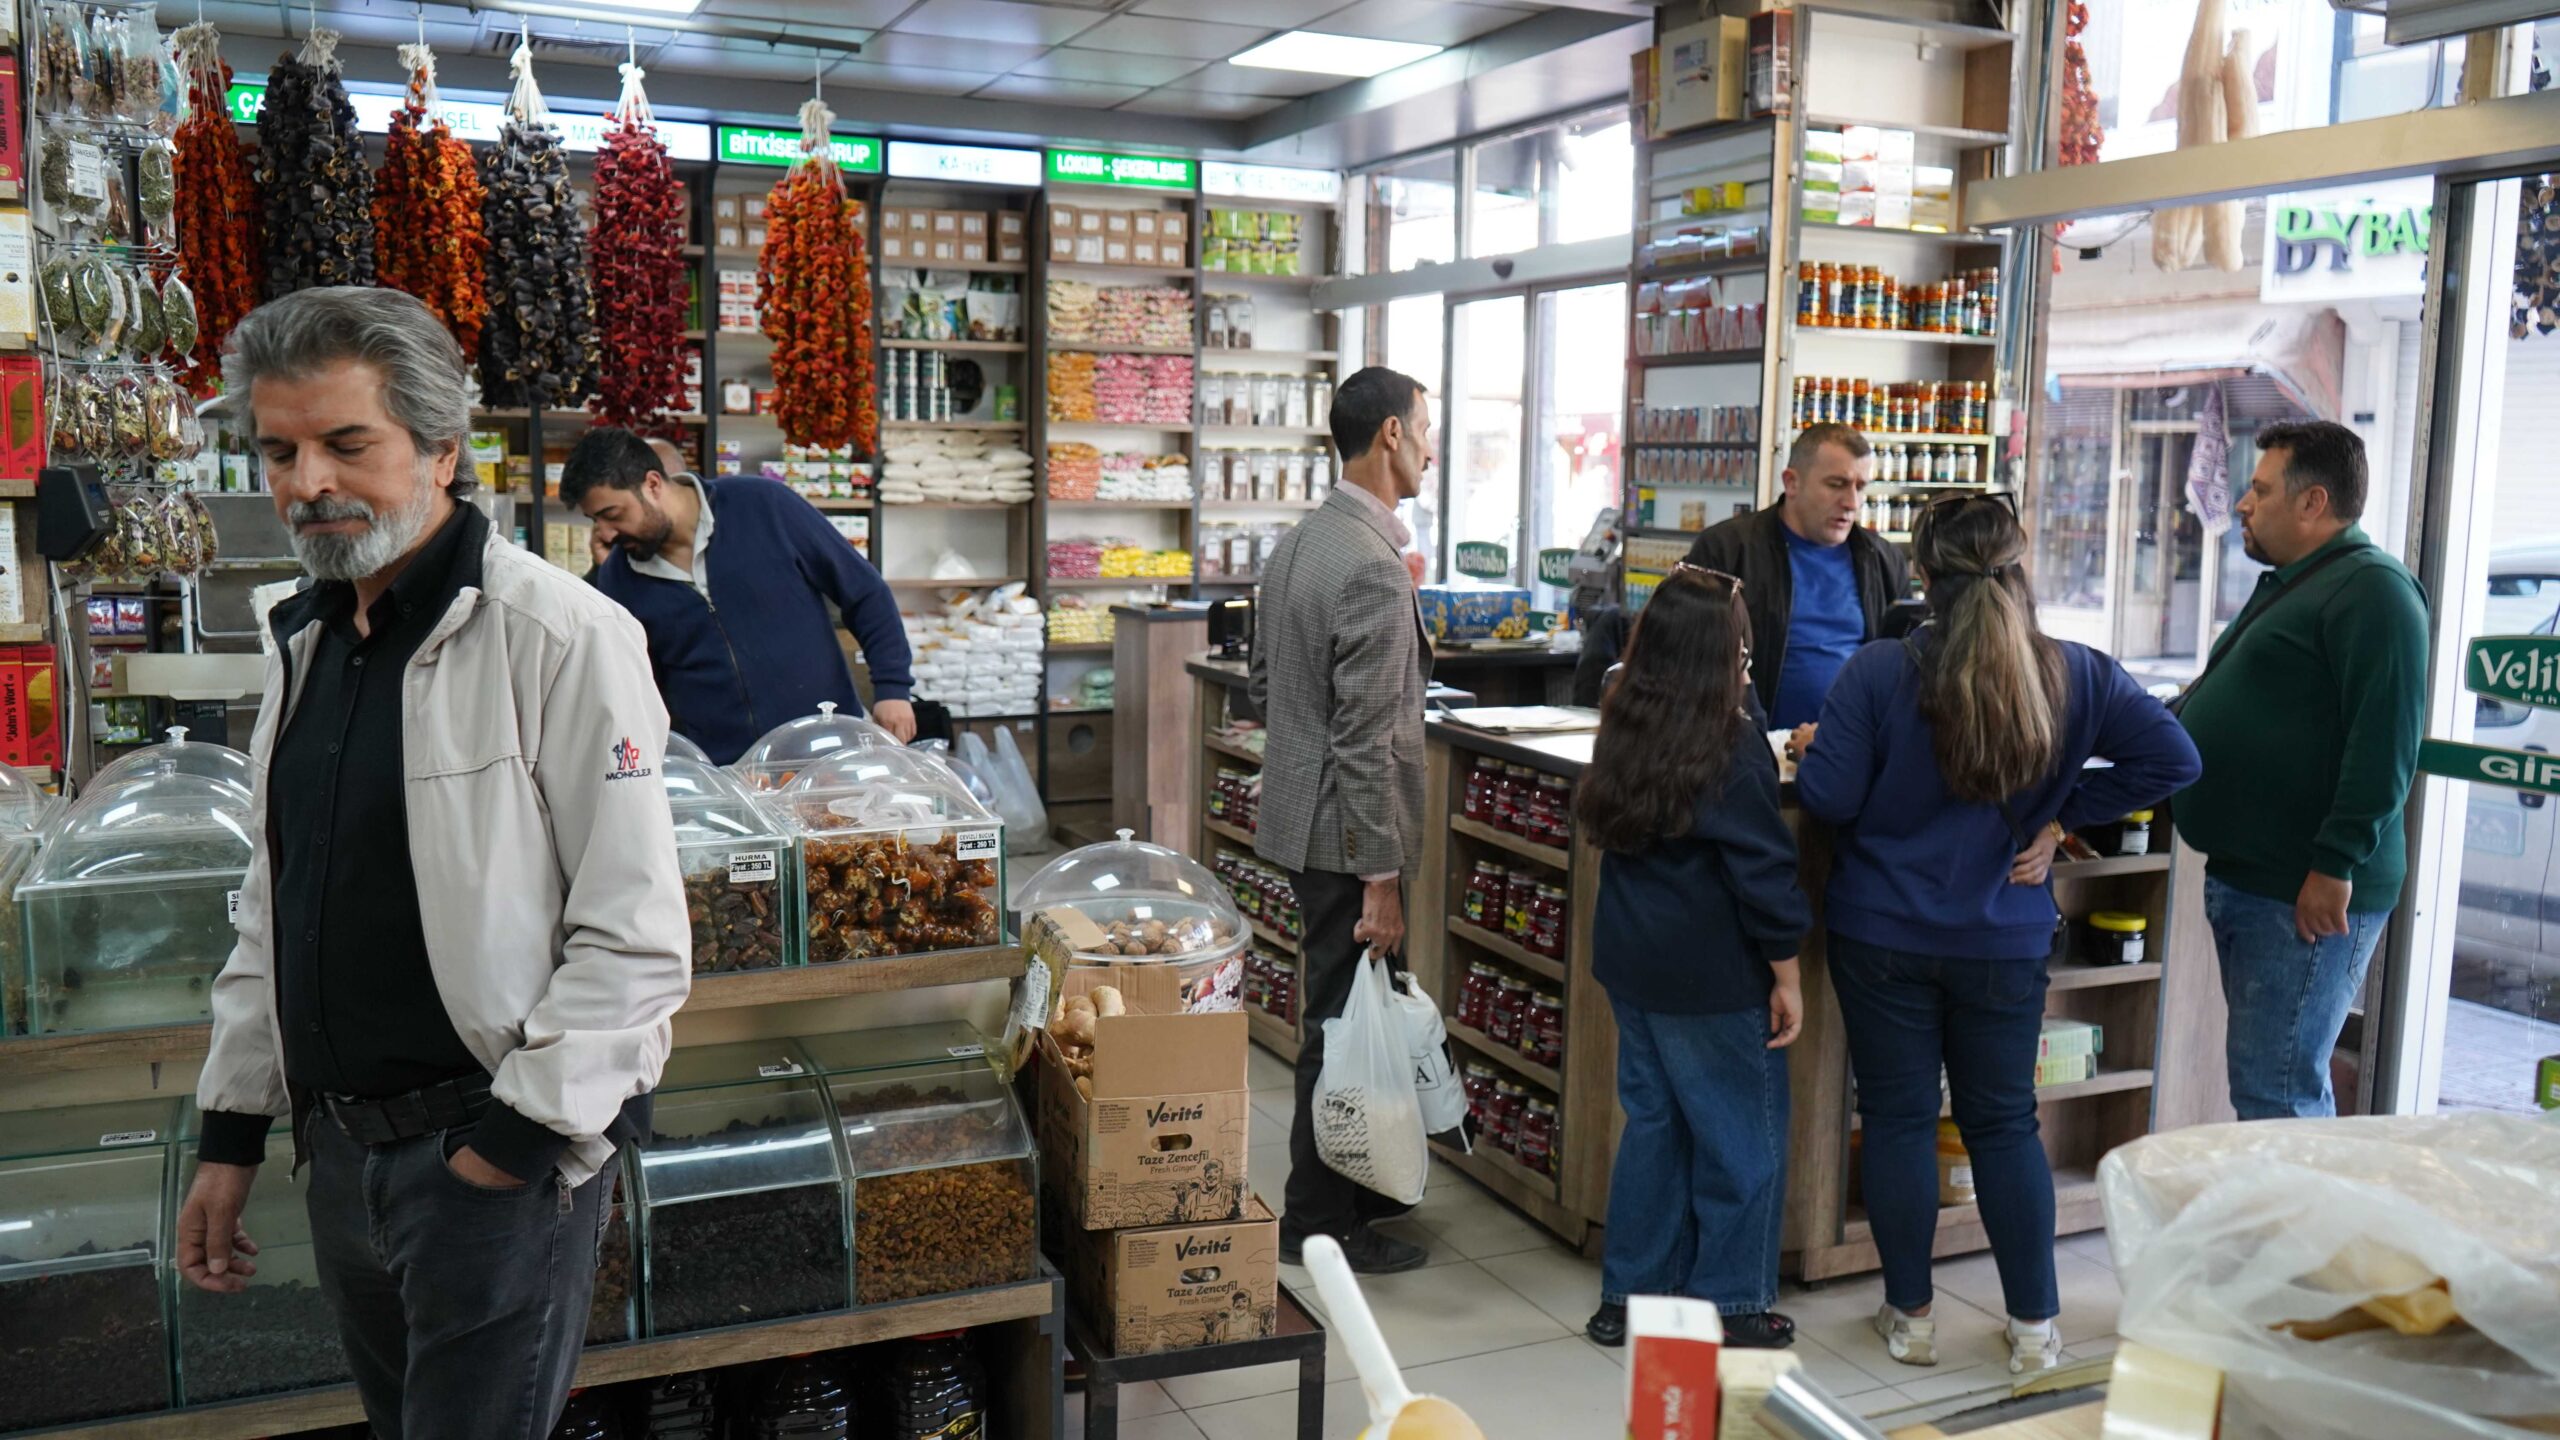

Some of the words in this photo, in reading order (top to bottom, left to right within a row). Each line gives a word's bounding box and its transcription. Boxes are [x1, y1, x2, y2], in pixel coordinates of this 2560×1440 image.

[811, 143, 870, 163] RUP
[4, 683, 16, 706] Wort
[5, 707, 18, 738] John's
[605, 768, 651, 781] MONCLER
[731, 863, 747, 872] Fiyat
[763, 861, 771, 869] TL
[1147, 1101, 1204, 1128] Veritá
[1137, 1155, 1164, 1165] Taze
[1168, 1150, 1209, 1164] Zencefil
[1150, 1166, 1171, 1174] Fresh
[1172, 1164, 1197, 1174] Ginger
[1175, 1236, 1232, 1261] Veritá
[1167, 1287, 1192, 1298] Taze
[1196, 1280, 1238, 1295] Zencefil
[1179, 1297, 1199, 1306] Fresh
[1202, 1295, 1226, 1305] Ginger
